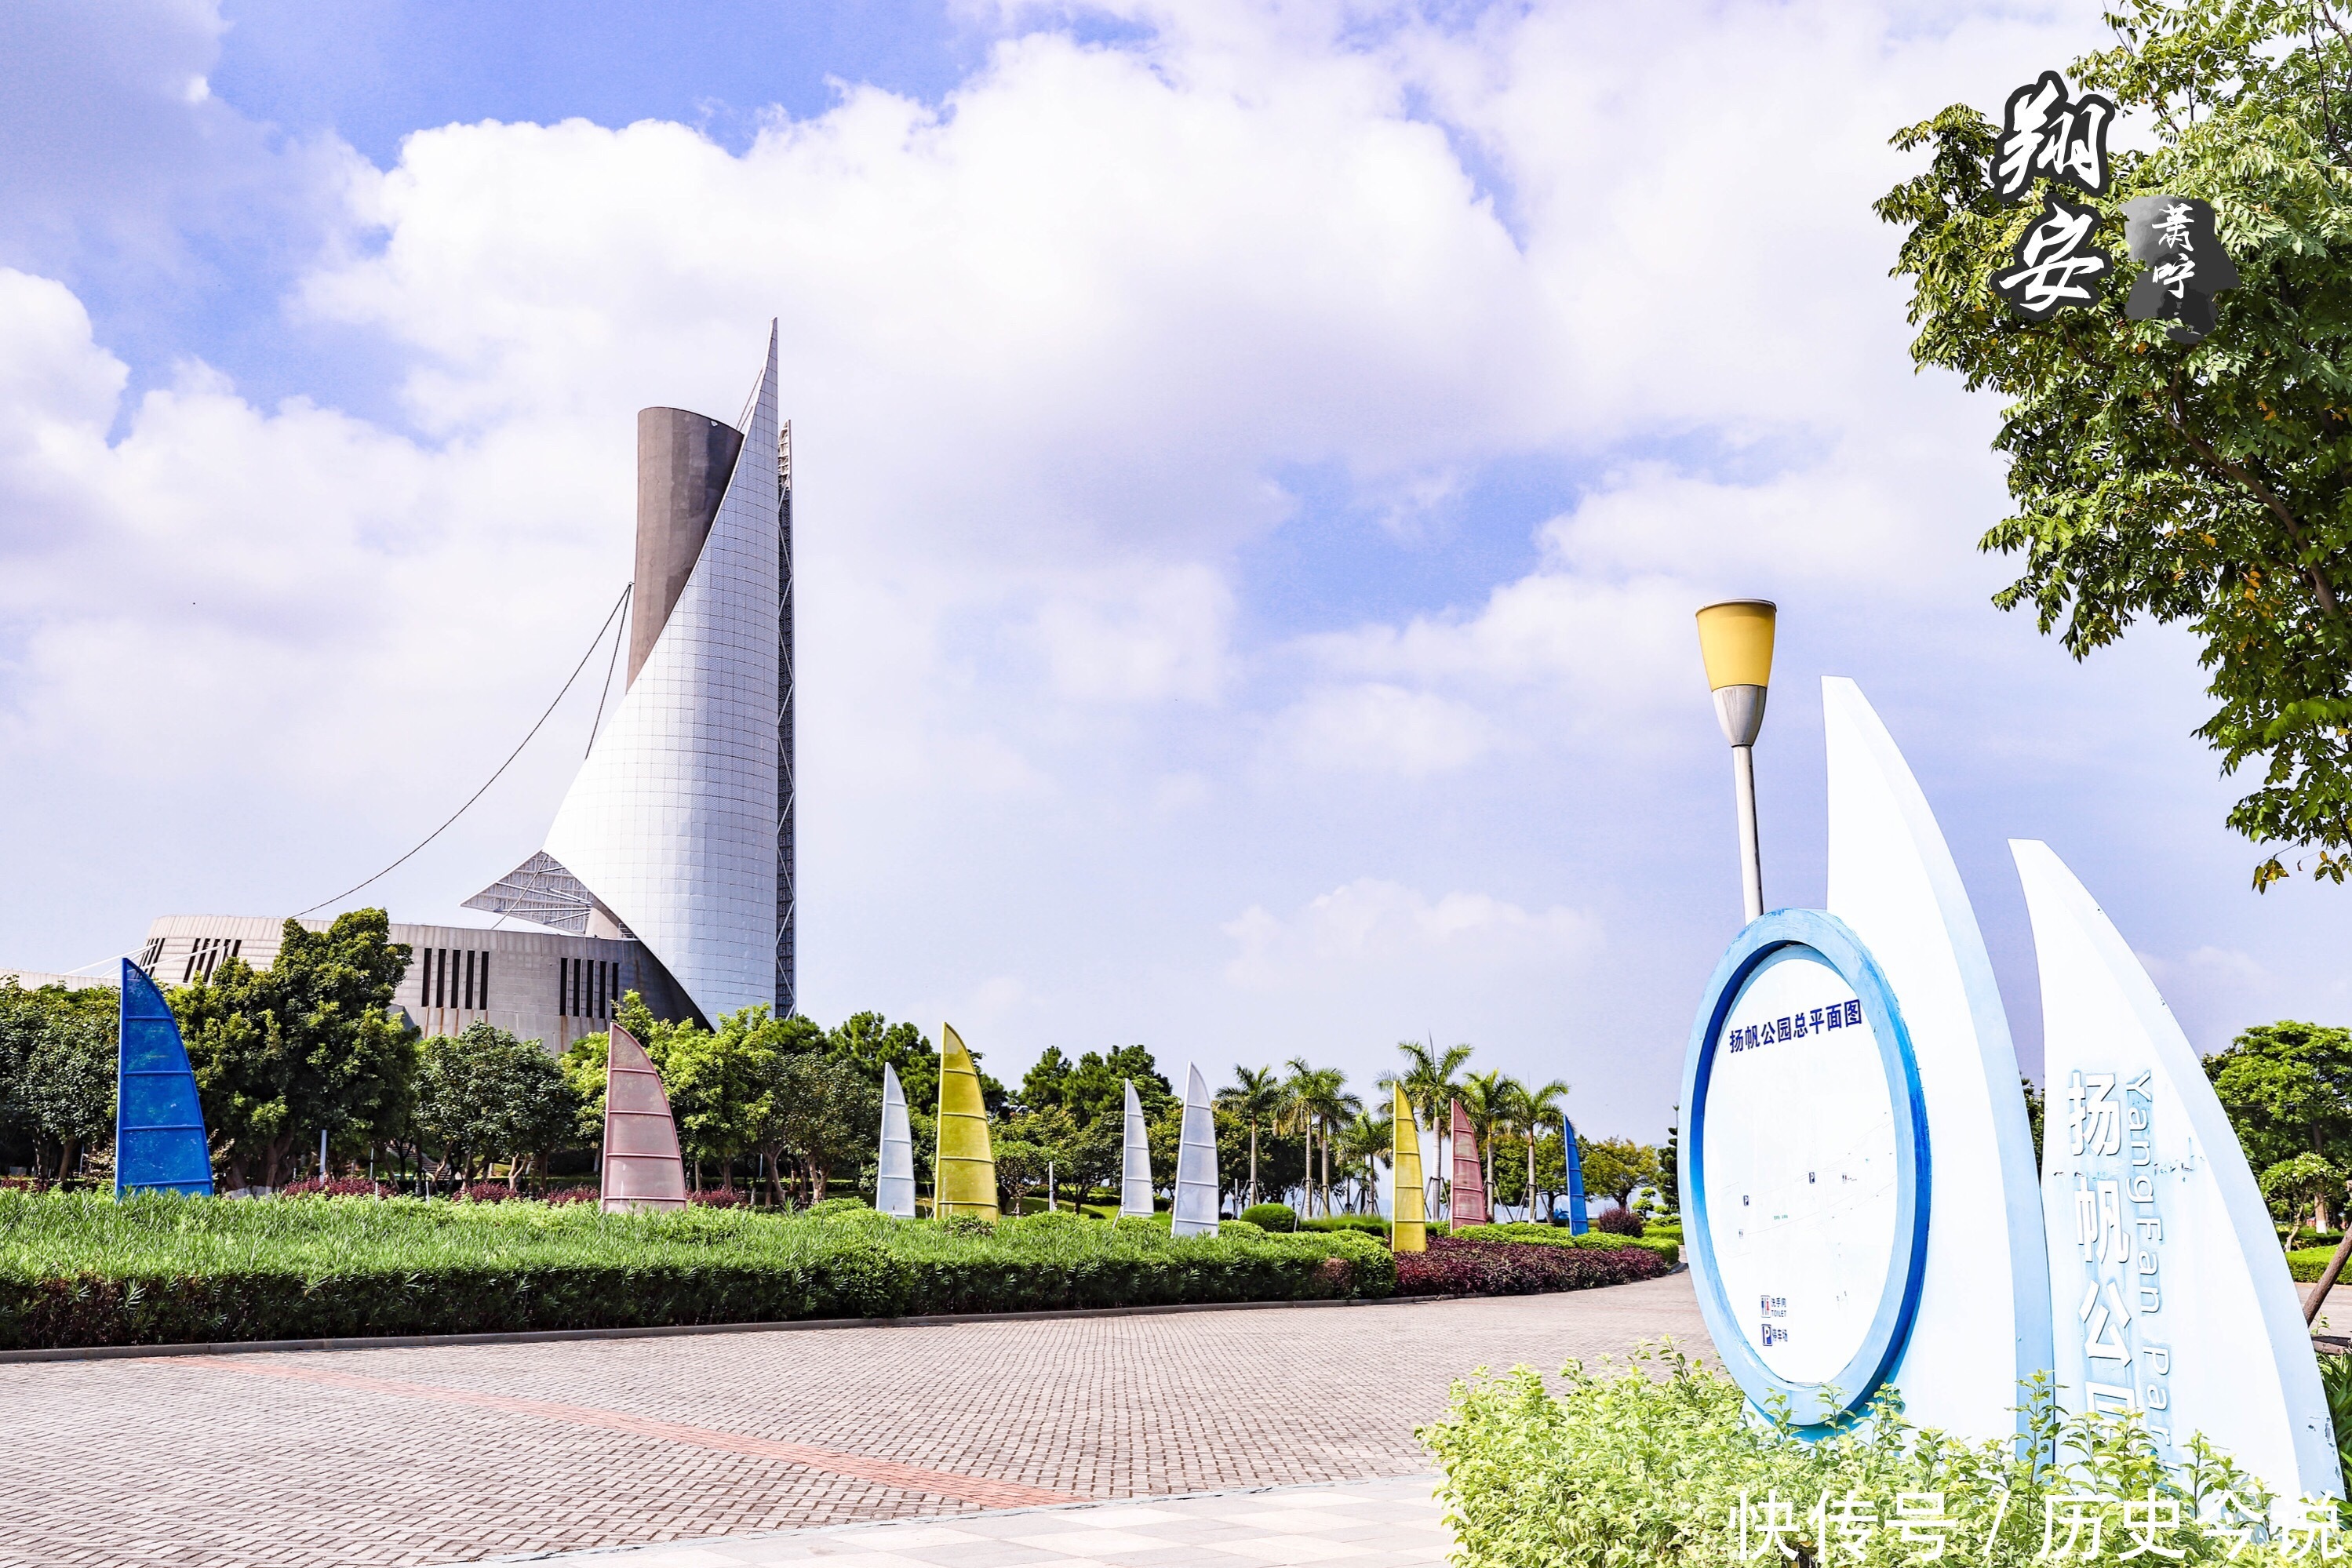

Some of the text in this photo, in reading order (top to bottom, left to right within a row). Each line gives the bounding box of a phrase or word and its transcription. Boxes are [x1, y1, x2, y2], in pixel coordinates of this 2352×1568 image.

[1729, 999, 1862, 1053] 扬帆公园总平面图
[2125, 1069, 2162, 1315] YangFan
